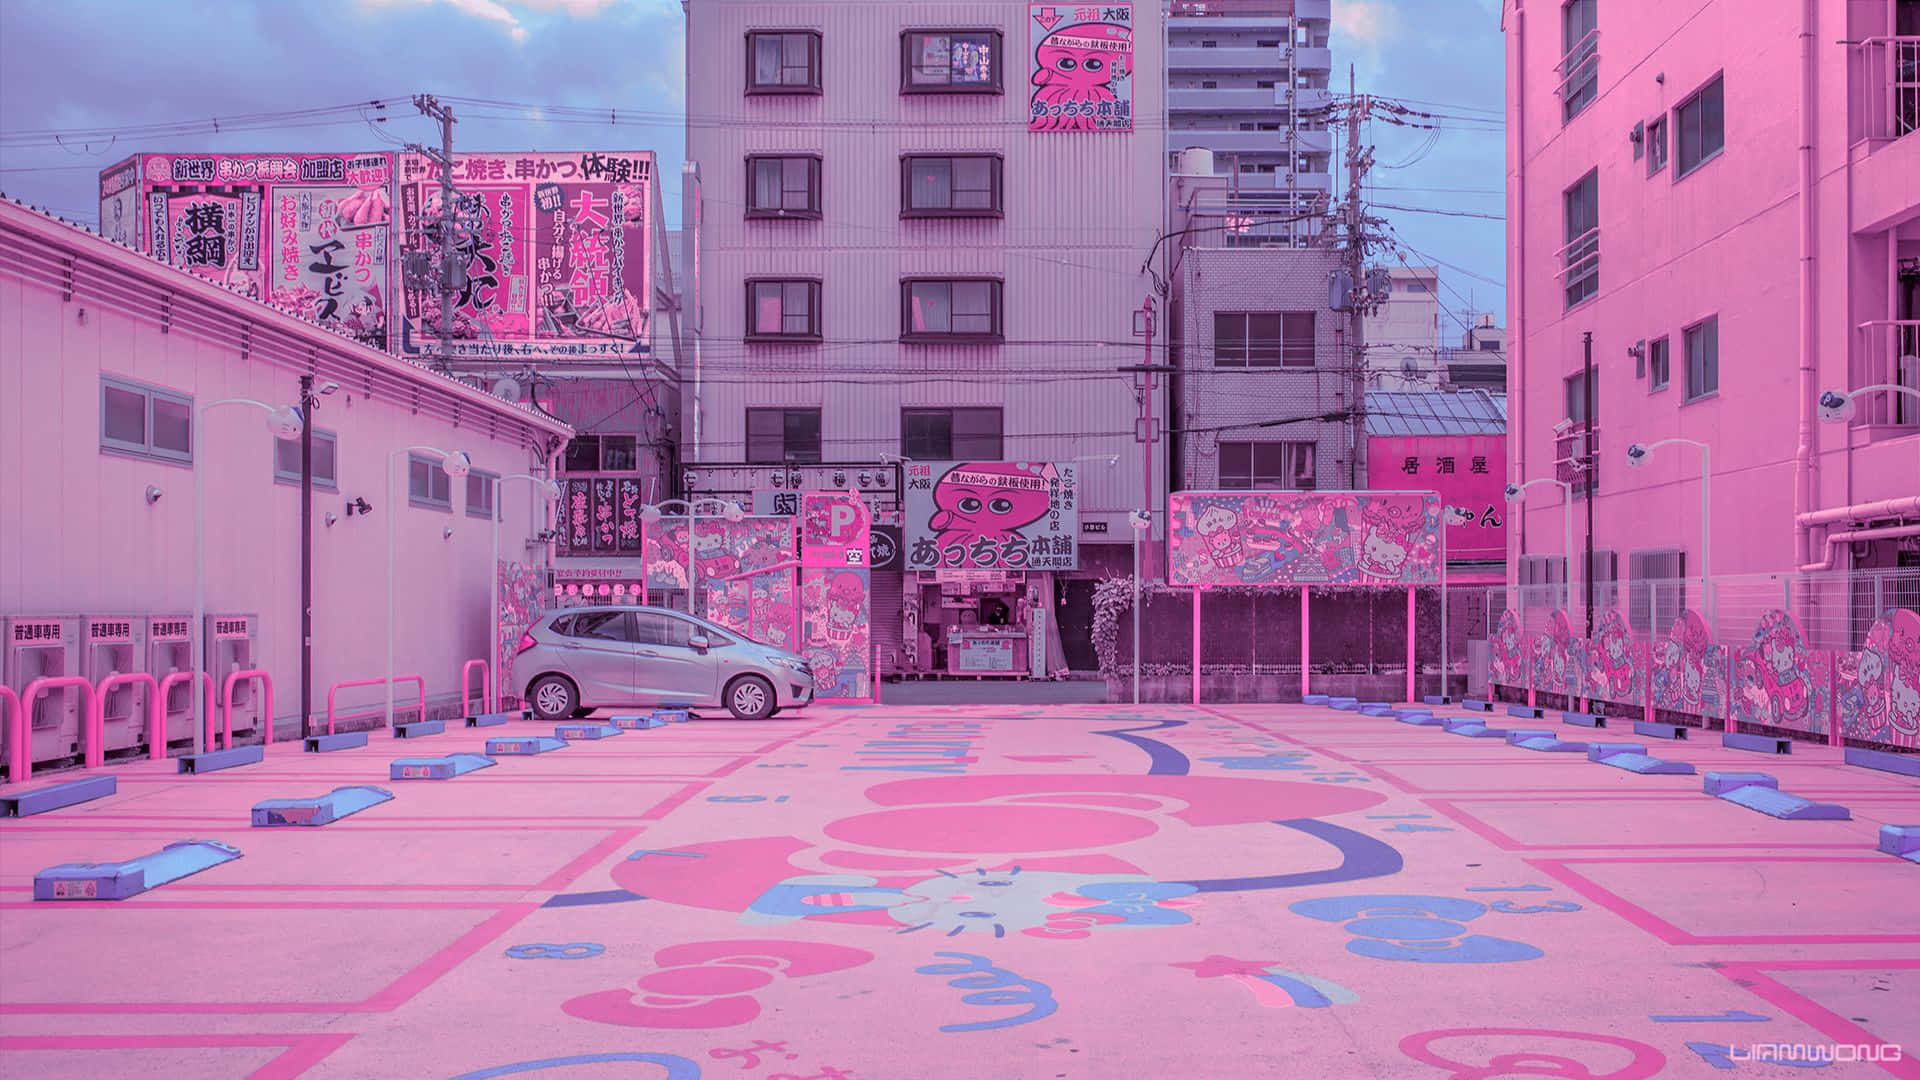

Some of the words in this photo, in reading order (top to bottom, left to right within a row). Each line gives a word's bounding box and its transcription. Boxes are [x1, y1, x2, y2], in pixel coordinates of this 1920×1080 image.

[1074, 8, 1100, 21] 元祖
[174, 158, 214, 179] 新世界
[302, 158, 344, 179] 加盟店
[184, 201, 226, 267] 横綱
[280, 195, 300, 281] お好み焼き
[354, 231, 373, 283] 串かつ
[569, 190, 610, 307] 大統領
[908, 464, 931, 477] 元祖
[1401, 456, 1489, 475] 居酒屋
[908, 478, 931, 490] 大阪
[950, 472, 1046, 489] 昔ながらの鉄板使用!
[1063, 468, 1074, 511] たこ焼き
[831, 505, 857, 537] P
[910, 535, 1073, 567] あっちち本舗
[14, 623, 61, 641] 普通車専用
[91, 622, 131, 638] 普通車専用
[152, 621, 188, 637] 普通車専用
[215, 620, 247, 635] 普通車専用
